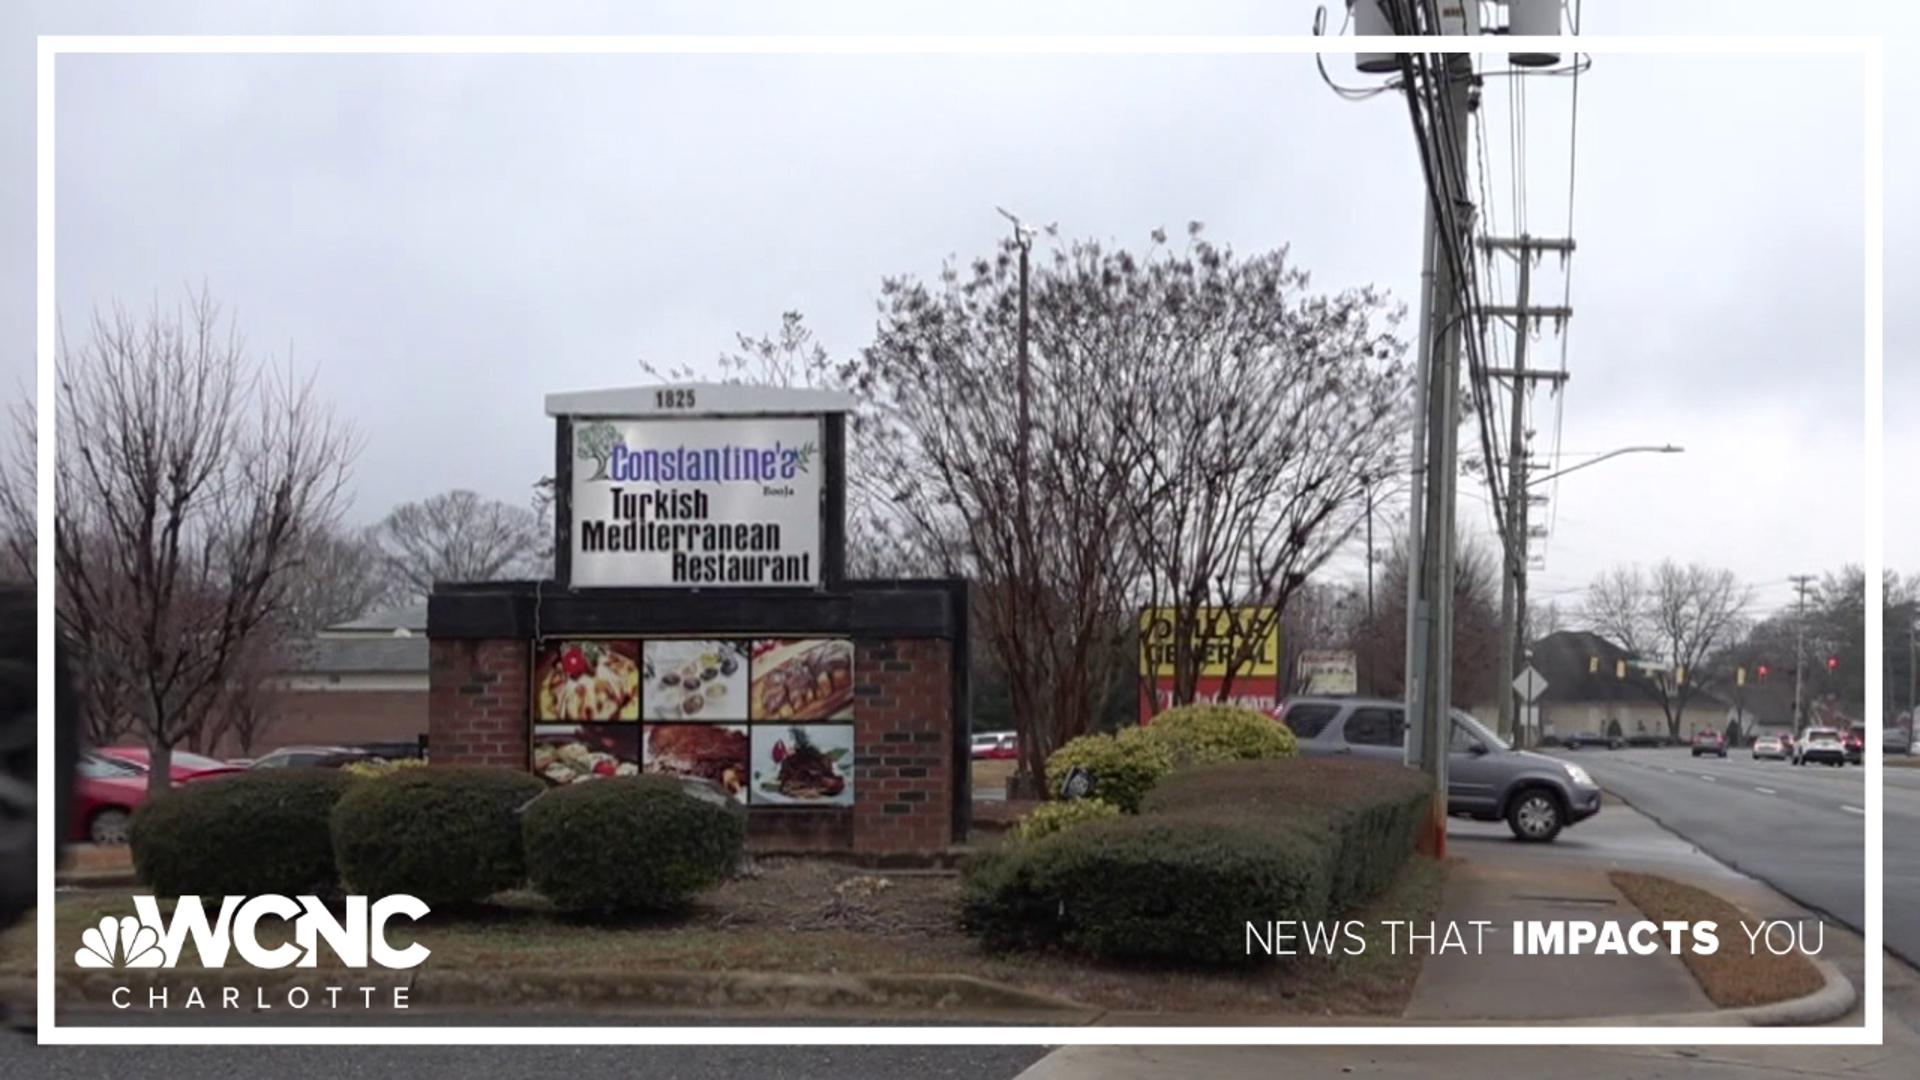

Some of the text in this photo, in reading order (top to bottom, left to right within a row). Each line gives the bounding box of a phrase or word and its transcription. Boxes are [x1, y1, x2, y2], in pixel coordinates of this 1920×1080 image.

[656, 390, 696, 408] 1825
[611, 441, 798, 486] Constantine's
[610, 487, 708, 520] Turkish
[581, 520, 780, 552] Mediterranean
[672, 552, 810, 583] Restaurant
